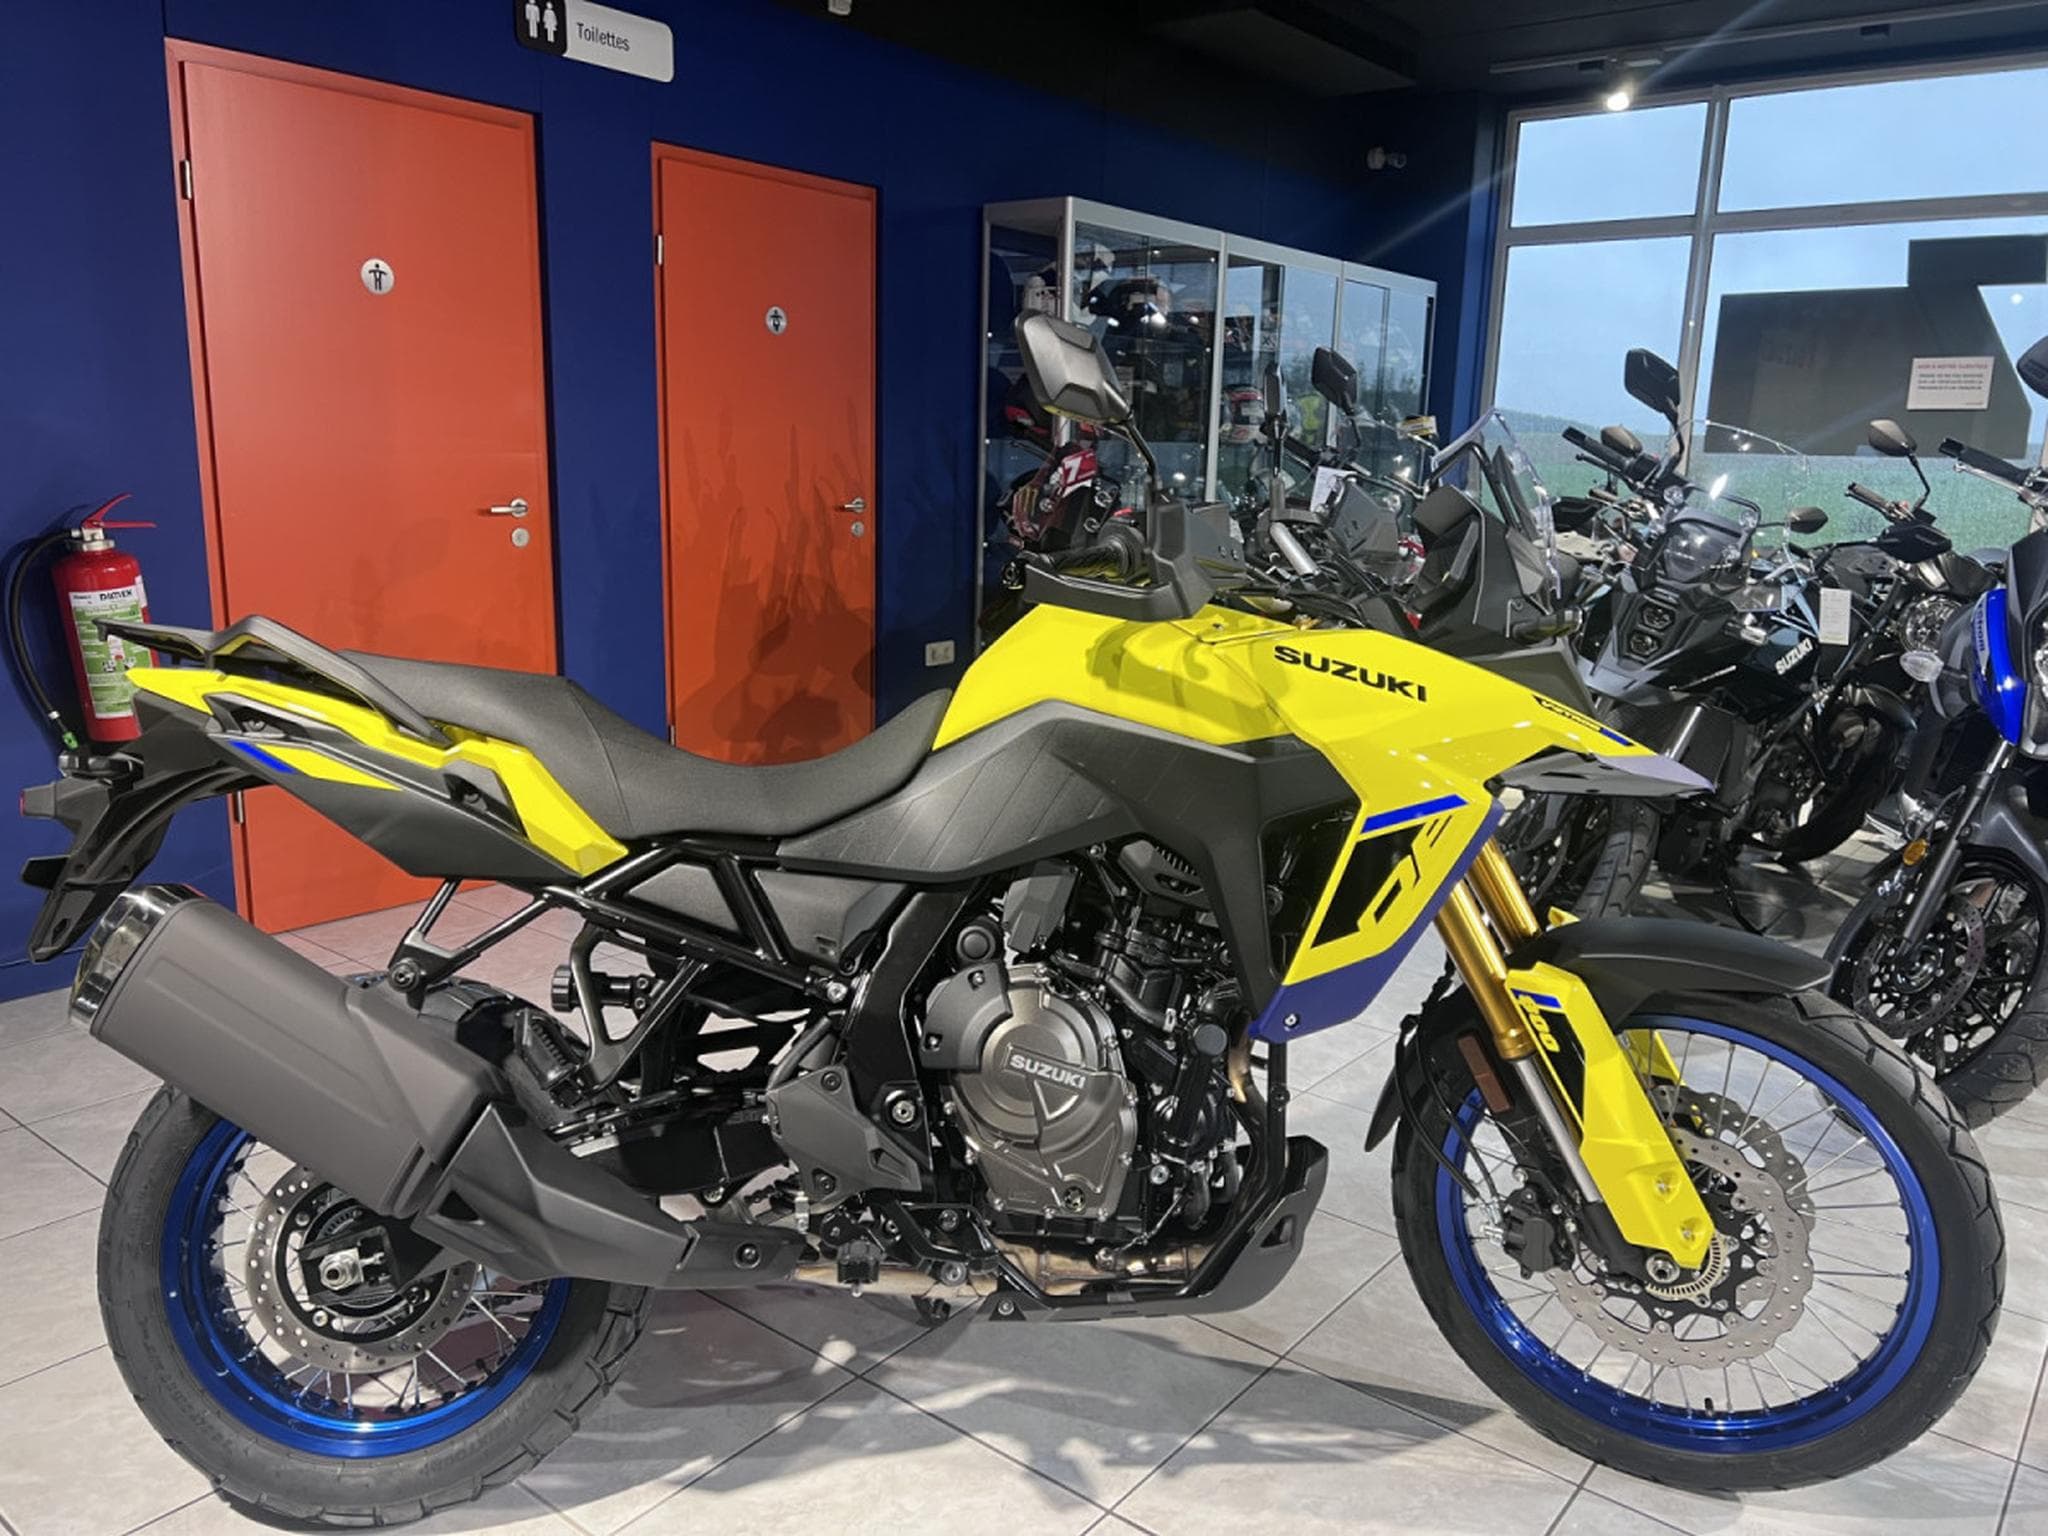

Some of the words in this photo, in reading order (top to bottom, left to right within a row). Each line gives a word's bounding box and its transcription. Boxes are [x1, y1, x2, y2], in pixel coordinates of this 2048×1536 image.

[576, 22, 631, 52] Toilettes
[1273, 645, 1428, 703] SUZUKI
[1774, 637, 1814, 676] SUZUKI
[1518, 994, 1561, 1053] 800
[1009, 1053, 1087, 1090] SUZUKI
